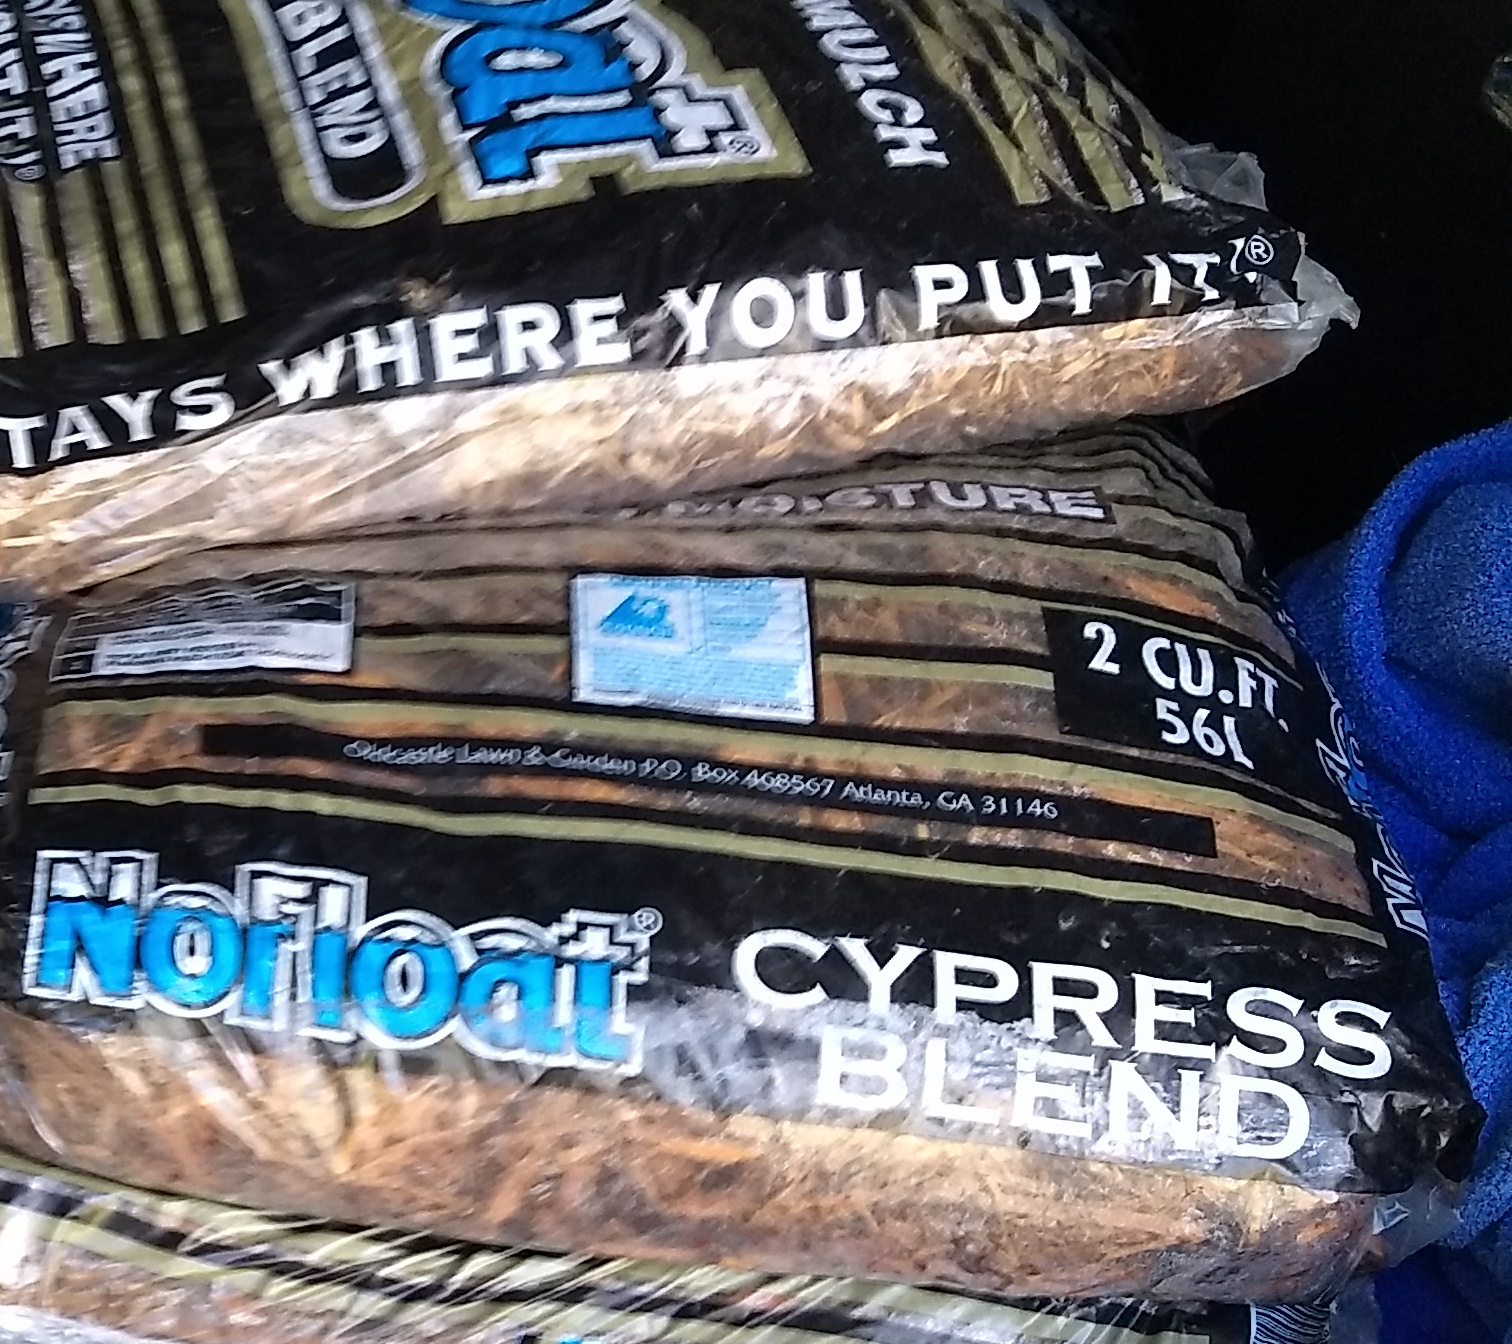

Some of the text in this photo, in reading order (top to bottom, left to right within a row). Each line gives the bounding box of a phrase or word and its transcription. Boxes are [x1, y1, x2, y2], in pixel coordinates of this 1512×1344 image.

[258, 294, 631, 408] WHERE
[658, 267, 866, 357] YOU
[910, 251, 1103, 332] PUT
[1081, 621, 1290, 733] 2 CU.FT.
[1155, 699, 1255, 770] 56L
[455, 742, 522, 765] Lawn
[522, 744, 544, 766] &
[548, 747, 636, 776] Garden
[838, 782, 931, 809] Atlanta,
[938, 792, 975, 814] GA
[982, 795, 1059, 821] 31146
[731, 928, 1394, 1080] CYPRESS
[814, 1024, 1312, 1161] BLEND
